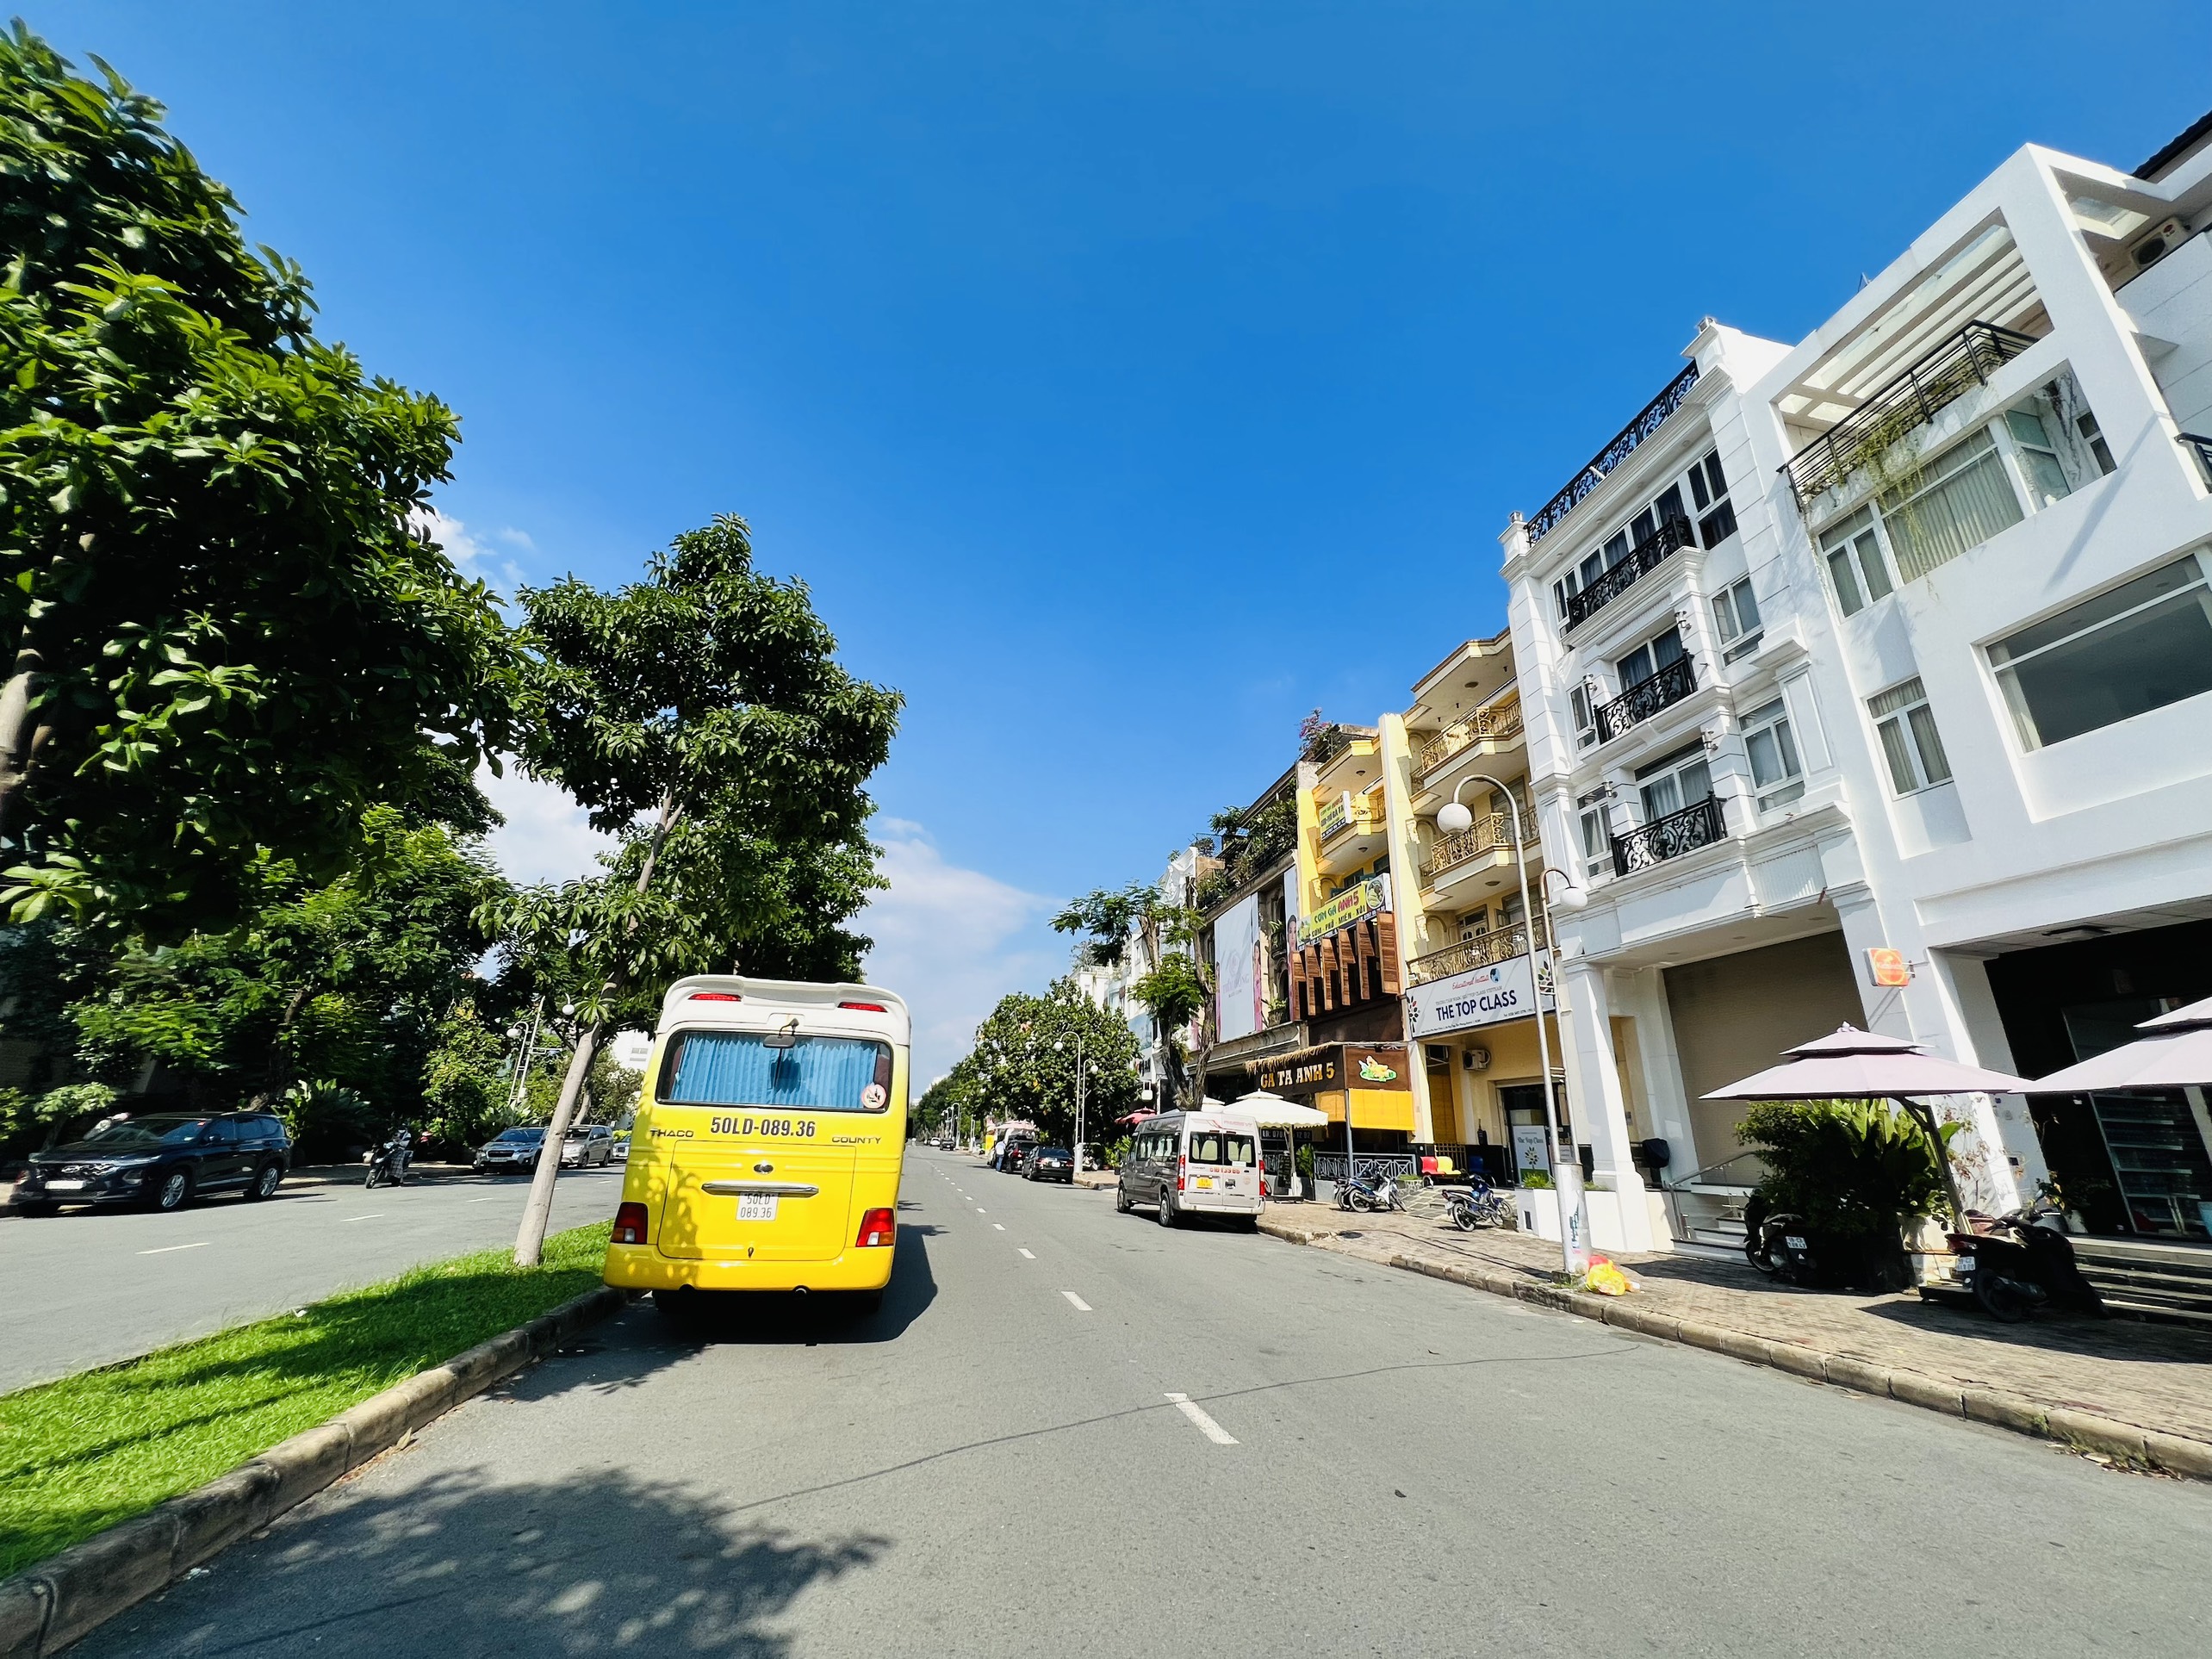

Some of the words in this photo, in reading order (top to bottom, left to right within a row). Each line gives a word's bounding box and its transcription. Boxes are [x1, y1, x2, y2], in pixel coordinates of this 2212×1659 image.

[1436, 1003, 1455, 1022] THE
[1456, 998, 1477, 1017] TOP
[1479, 989, 1518, 1012] CLASS
[1277, 1068, 1293, 1087] TA
[1296, 1062, 1323, 1084] ANH
[1326, 1061, 1335, 1080] 5
[649, 1128, 695, 1138] THACO
[710, 1116, 817, 1138] 50LD-089.36
[831, 1135, 882, 1145] COUNTY
[746, 1193, 772, 1205] 50LD
[740, 1207, 773, 1218] 089.36
